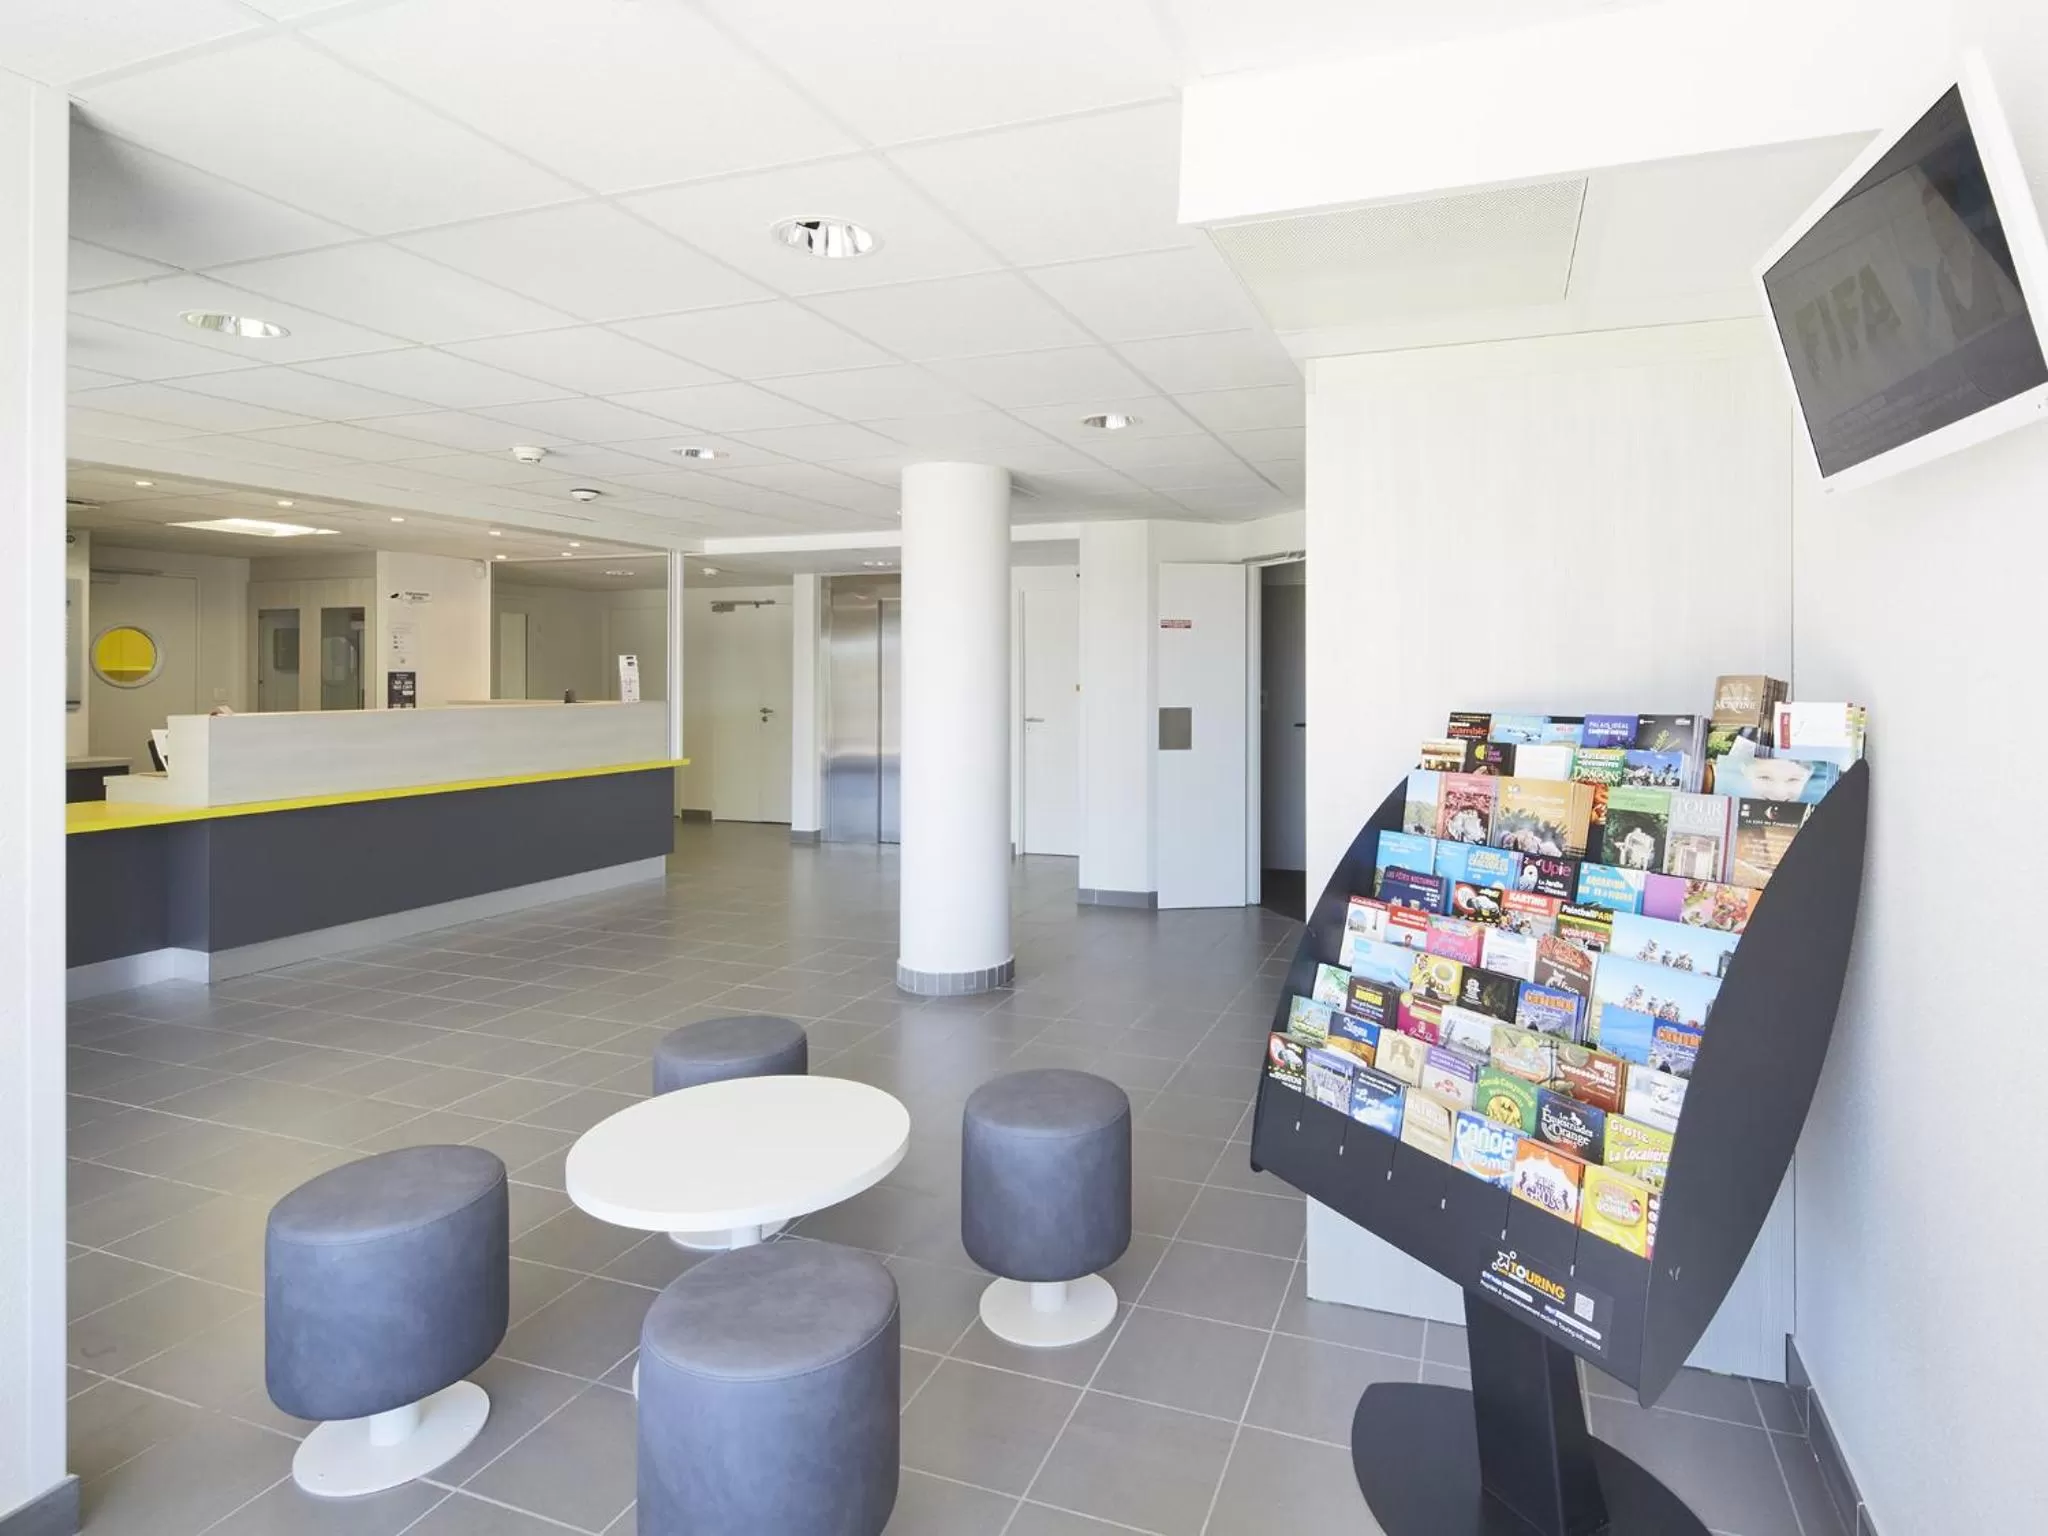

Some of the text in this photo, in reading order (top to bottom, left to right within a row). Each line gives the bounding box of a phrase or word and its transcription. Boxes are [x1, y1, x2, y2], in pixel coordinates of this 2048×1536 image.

[1794, 263, 1902, 384] FIFA
[1609, 1119, 1650, 1144] Grotte
[1509, 1261, 1566, 1299] TOURING
